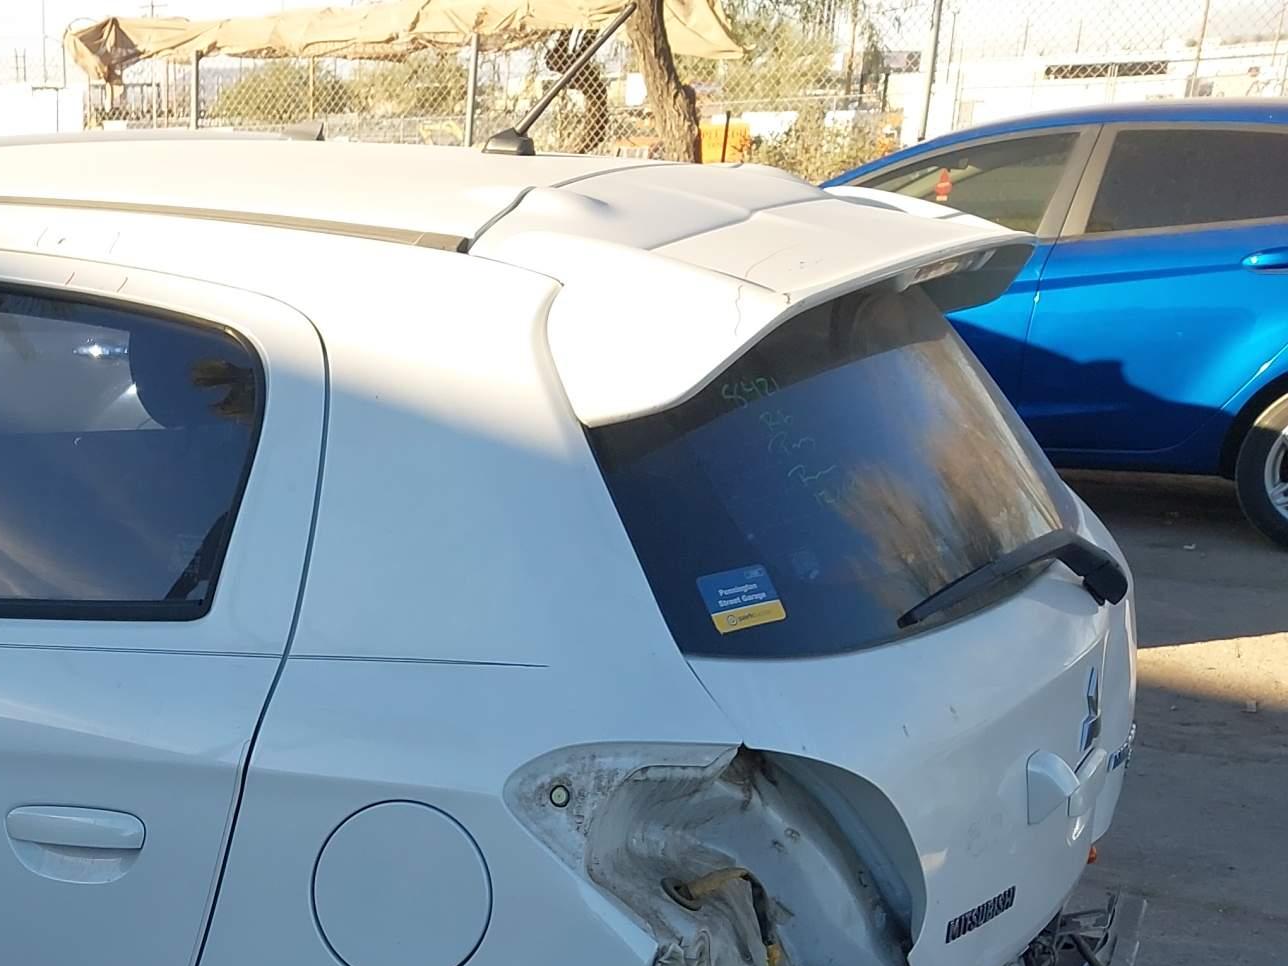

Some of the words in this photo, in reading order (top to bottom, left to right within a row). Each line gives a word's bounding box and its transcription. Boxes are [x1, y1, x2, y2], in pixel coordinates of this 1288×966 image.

[718, 596, 742, 607] Street
[741, 592, 767, 602] Garage
[945, 885, 1016, 944] MITSUBISHI
